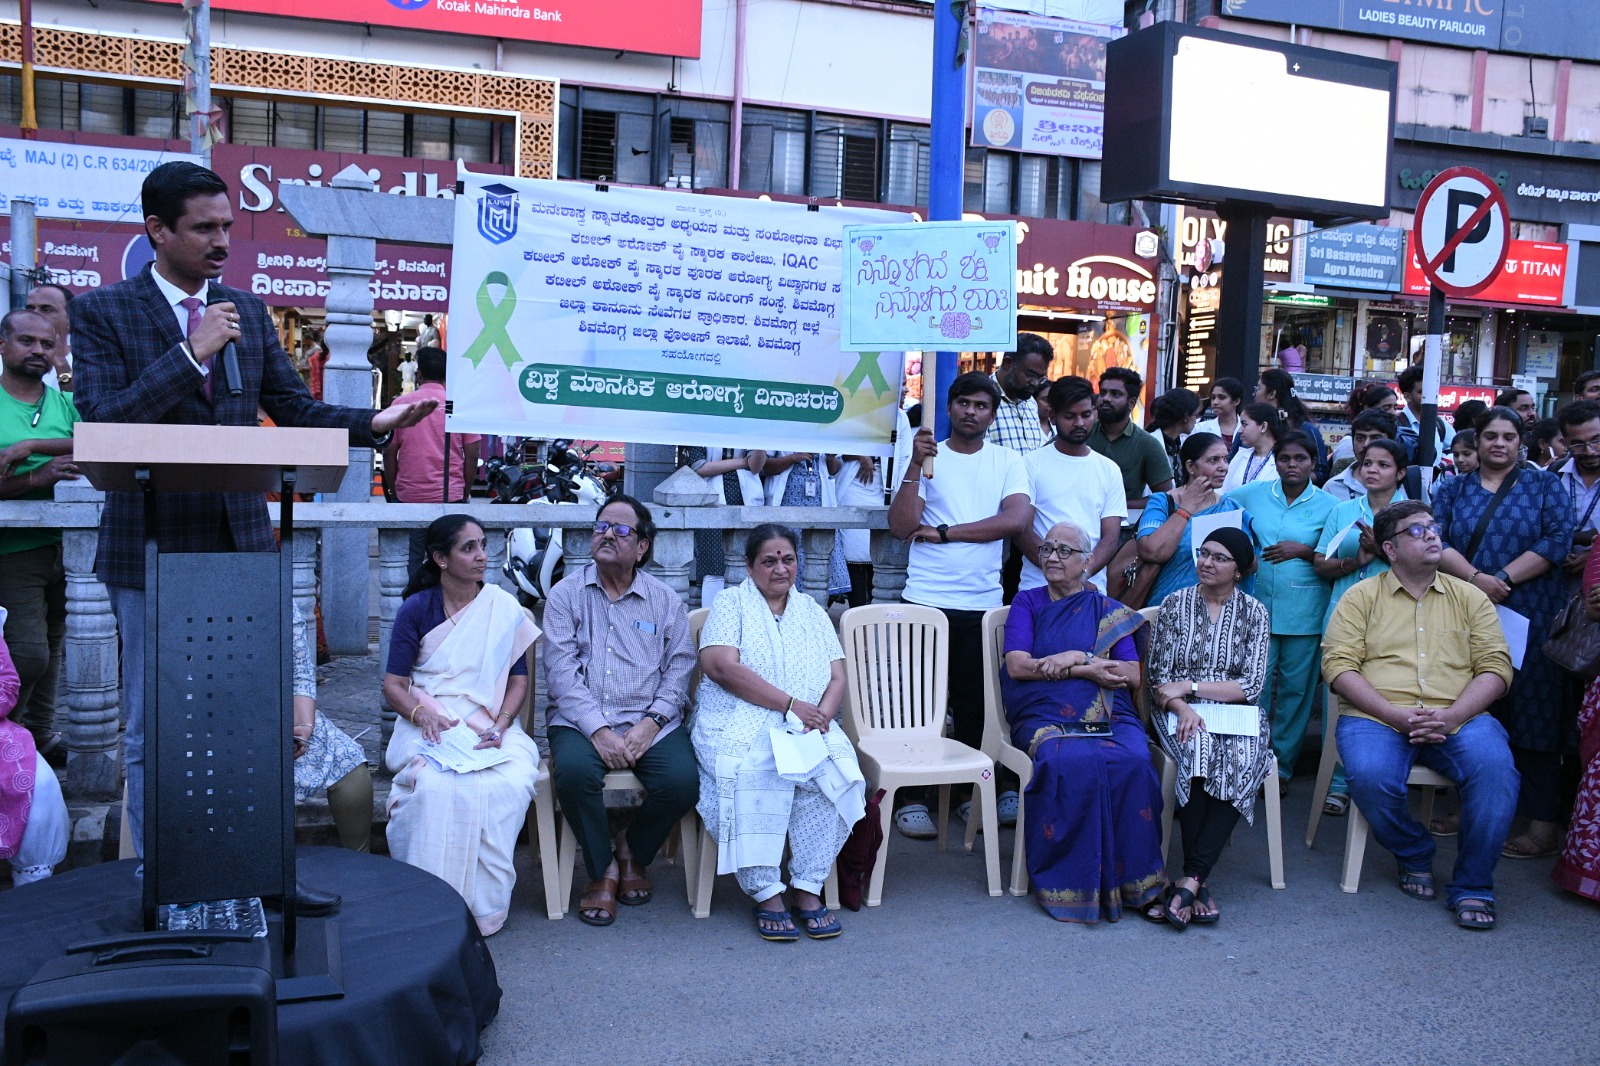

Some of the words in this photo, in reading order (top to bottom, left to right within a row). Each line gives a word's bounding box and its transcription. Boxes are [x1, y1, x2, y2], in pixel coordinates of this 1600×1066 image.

[437, 0, 471, 12] Kotak
[475, 3, 530, 19] Mahindra
[534, 8, 562, 22] Bank
[1359, 8, 1396, 24] LADIES
[1398, 14, 1437, 29] BEAUTY
[1439, 19, 1486, 36] PARLOUR
[25, 150, 56, 166] MAJ
[61, 153, 78, 170] (2)
[84, 155, 107, 170] C.R
[532, 202, 586, 226] ಮನಃಶಾಸ್ತ್ರ
[592, 210, 665, 230] ಸ್ನಾತಕೋತ್ತರ
[671, 220, 718, 236] ಅಧ್ಯಯನ
[723, 225, 750, 241] ಮತ್ತು
[755, 229, 818, 246] ಸಂಶೋಧನಾ
[571, 232, 611, 246] ಕಟೀಲ್
[617, 238, 666, 253] ಅಶೋಕ್
[672, 243, 685, 261] ಪೈ
[690, 246, 725, 263] ಸ್ಮಾರಕ
[783, 253, 818, 270] IQAC
[1321, 229, 1353, 248] ಬಸವೇಶ್ವರ
[1355, 232, 1376, 249] ಆಗ್ರೋ
[1379, 235, 1399, 251] ಕೇಂದ್ರ
[257, 253, 294, 269] ಶ್ರೀನಿಧಿ
[397, 259, 446, 277] ಶಿವಮೊಗ್ಗ
[1310, 246, 1325, 259] Sri
[1326, 247, 1397, 266] Basaveshwara
[1521, 260, 1561, 277] TITAN
[523, 250, 565, 264] ಕಟೀಲ್
[571, 254, 621, 270] ಅಶೋಕ್
[627, 259, 640, 278] ಪೈ
[646, 262, 681, 280] ಸ್ಮಾರಕ
[687, 266, 723, 280] ಪೂರಕ
[728, 270, 772, 291] ಆರೋಗ್ಯ
[778, 276, 826, 295] ವಿಜ್ಞಾನಗಳ
[1324, 262, 1347, 276] Agro
[1349, 265, 1384, 279] Kendra
[545, 274, 586, 288] ಕಟೀಲ್
[592, 278, 642, 294] ಅಶೋಕ್
[648, 283, 661, 301] ಪೈ
[667, 286, 702, 303] ಸ್ಮಾರಕ
[707, 290, 754, 305] ನರ್ಸಿಂಗ್
[793, 299, 836, 318] ಶಿವಮೊಗ್ಗ
[1066, 266, 1156, 304] House
[559, 298, 586, 314] ಜಿಲ್ಲಾ
[592, 301, 642, 316] ಕಾನೂನು
[648, 304, 691, 320] ಸೇವೆಗಳ
[754, 314, 797, 335] ಶಿವಮೊಗ್ಗ
[802, 320, 820, 336] ಜಿಲ್ಲೆ
[578, 321, 626, 341] ಶಿವಮೊಗ್ಗ
[632, 326, 658, 342] ಜಿಲ್ಲಾ
[664, 328, 710, 343] ಪೊಲೀಸ್
[758, 337, 801, 356] ಶಿವಮೊಗ್ಗ
[661, 349, 721, 366] ಸಹಯೋಗದಲ್ಲಿ
[526, 369, 559, 400] ವಿಶ್ವ
[570, 372, 656, 397] ಮಾನಸಿಕ
[666, 379, 744, 413] ಆರೋಗ್ಯ
[754, 387, 839, 411] ದಿನಾಚರಣೆ
